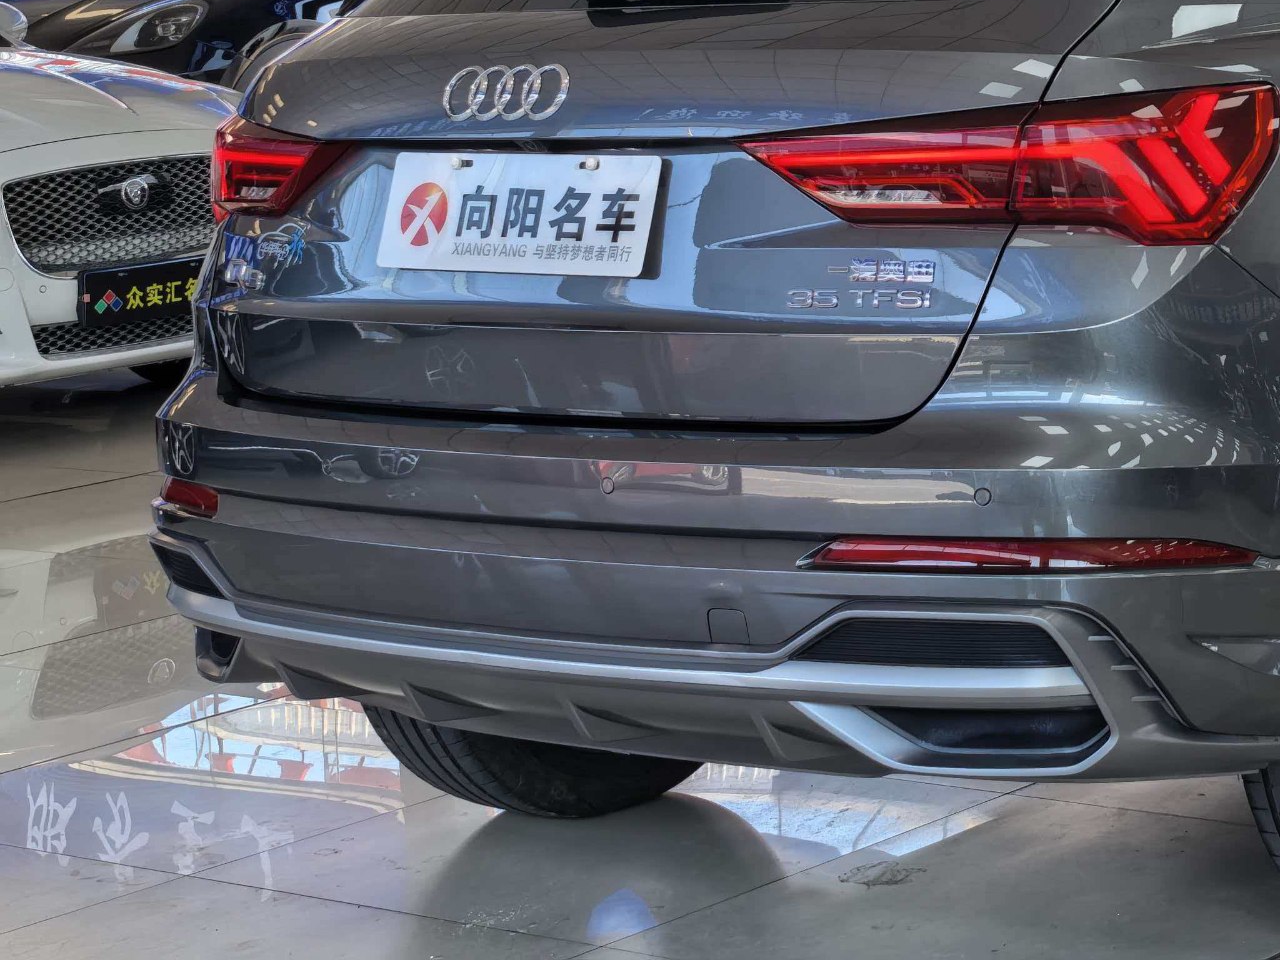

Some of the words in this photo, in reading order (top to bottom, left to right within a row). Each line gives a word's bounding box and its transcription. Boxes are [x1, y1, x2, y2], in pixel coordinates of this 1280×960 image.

[455, 184, 640, 243] 向阳名车
[451, 243, 527, 259] XIANGYANG
[532, 244, 632, 263] 与坚持梦想者同行
[786, 289, 839, 309] 35
[849, 289, 932, 309] TFSI
